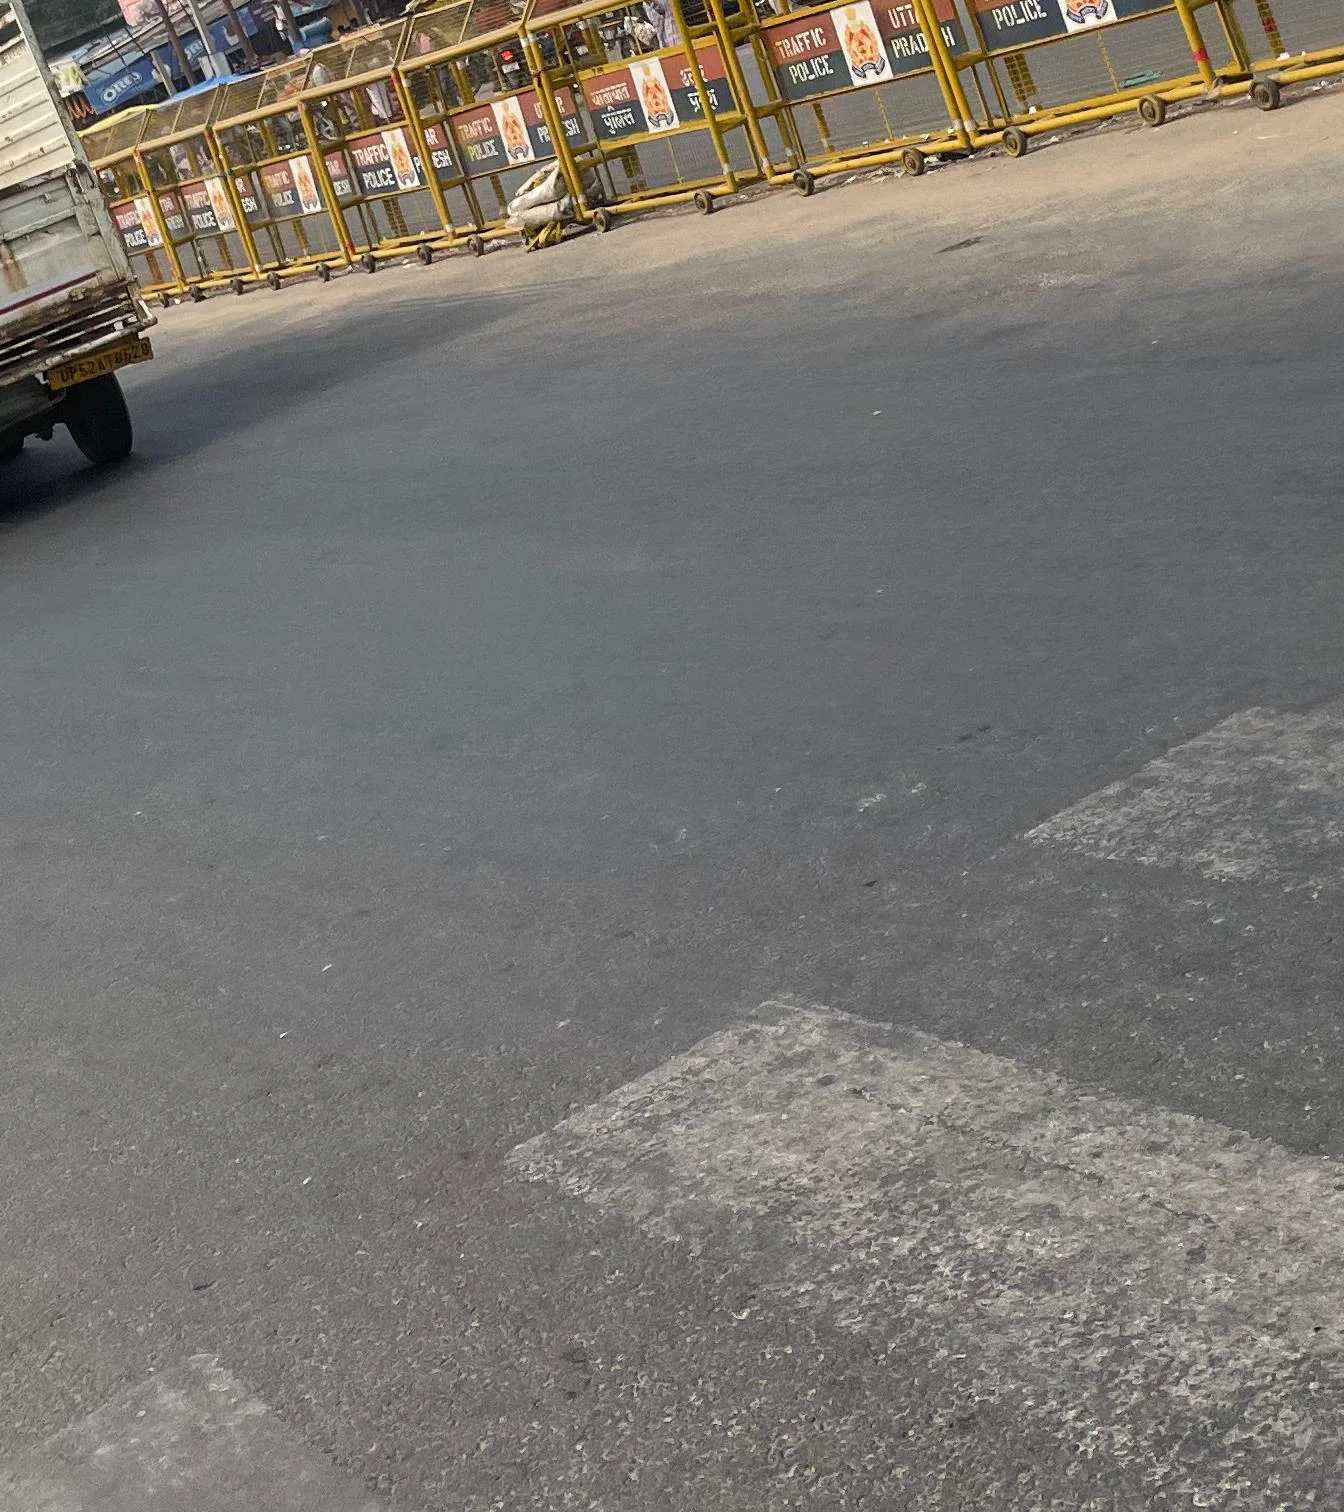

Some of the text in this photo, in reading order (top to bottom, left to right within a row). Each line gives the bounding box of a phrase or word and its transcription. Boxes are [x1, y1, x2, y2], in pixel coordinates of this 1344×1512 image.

[887, 4, 919, 29] UTT
[775, 27, 826, 59] TRAFFIC
[891, 26, 955, 58] PRADH
[789, 54, 834, 85] POLICE
[458, 117, 493, 140] TRAFFIC
[601, 105, 635, 134] पुलिस
[352, 143, 390, 168] TRAFFIC
[468, 139, 499, 162] POLICE
[364, 167, 396, 189] POLICE
[124, 229, 148, 248] POLICE
